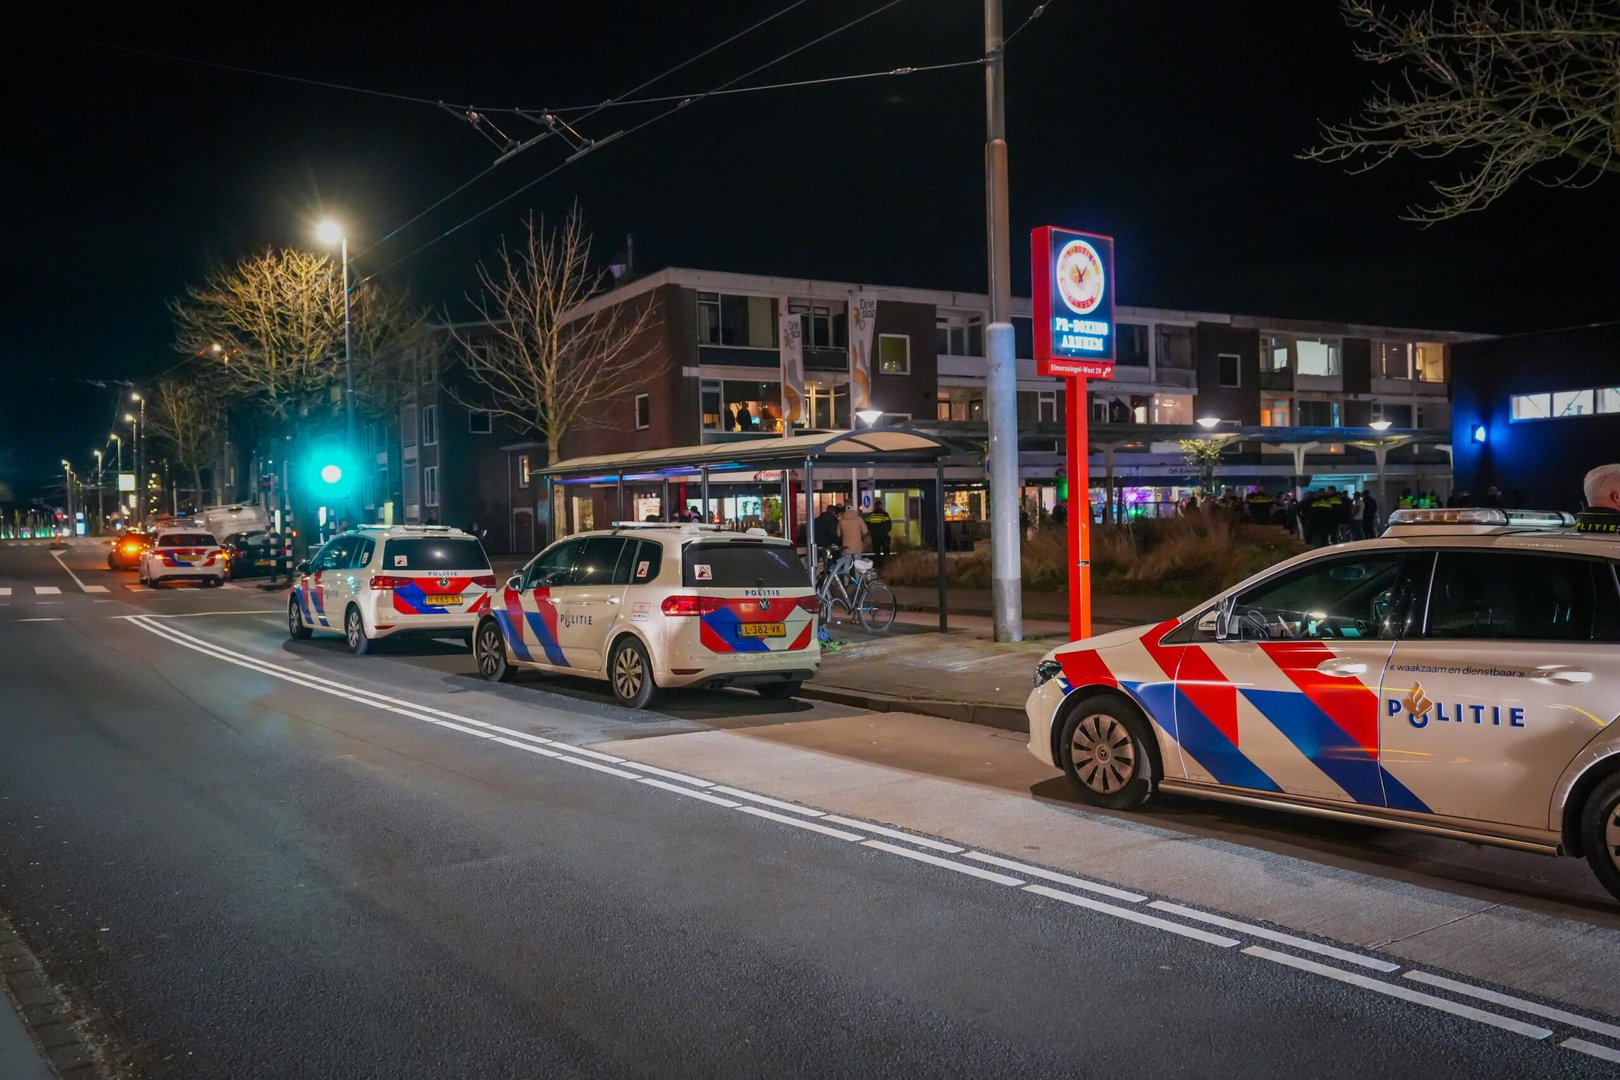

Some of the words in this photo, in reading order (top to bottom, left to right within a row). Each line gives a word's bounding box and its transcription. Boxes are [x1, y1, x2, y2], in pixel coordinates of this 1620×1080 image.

[745, 589, 781, 597] POLITIE
[560, 614, 593, 628] POLITIE
[1397, 664, 1447, 674] waakzaam
[1462, 666, 1517, 677] dienstbaar
[1388, 699, 1525, 729] POLITIE
